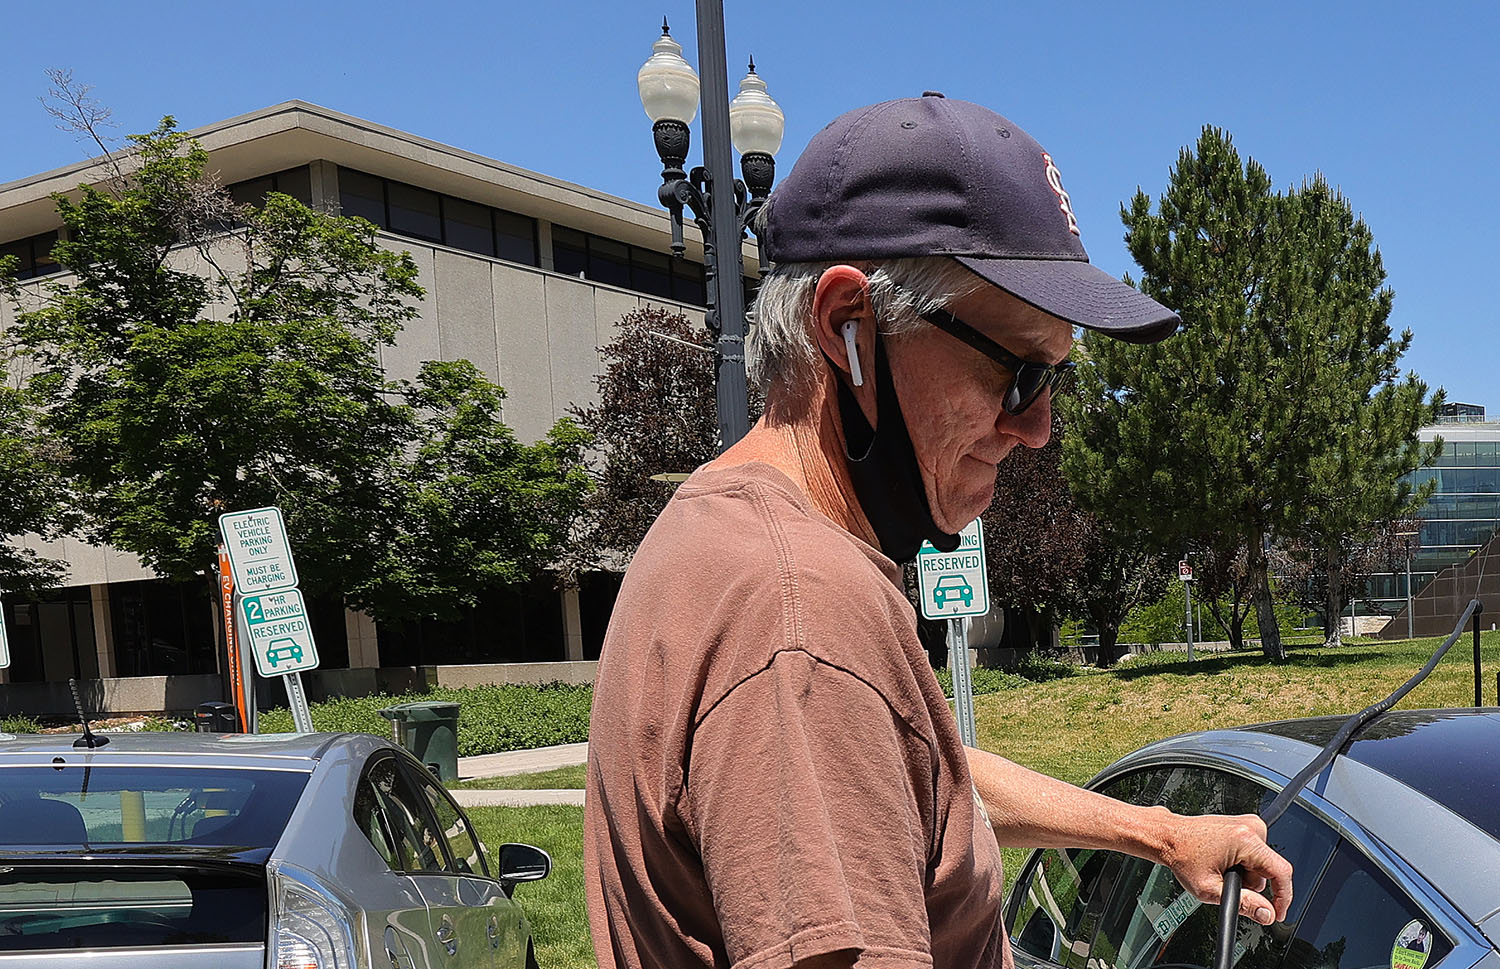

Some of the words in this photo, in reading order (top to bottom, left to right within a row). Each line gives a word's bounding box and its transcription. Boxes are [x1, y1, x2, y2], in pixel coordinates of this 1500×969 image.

[233, 517, 270, 530] ELECTRIC
[237, 527, 271, 539] VEHICLE
[239, 536, 273, 548] PARKING
[248, 546, 269, 556] ONLY
[246, 566, 267, 577] MUST
[270, 563, 281, 572] BE
[923, 556, 979, 572] RESERVED
[222, 575, 231, 590] EV
[246, 572, 286, 586] CHARGING
[247, 601, 262, 620] 2
[274, 595, 286, 606] HR
[264, 603, 300, 618] PARKING
[253, 621, 305, 639] RESERVED
